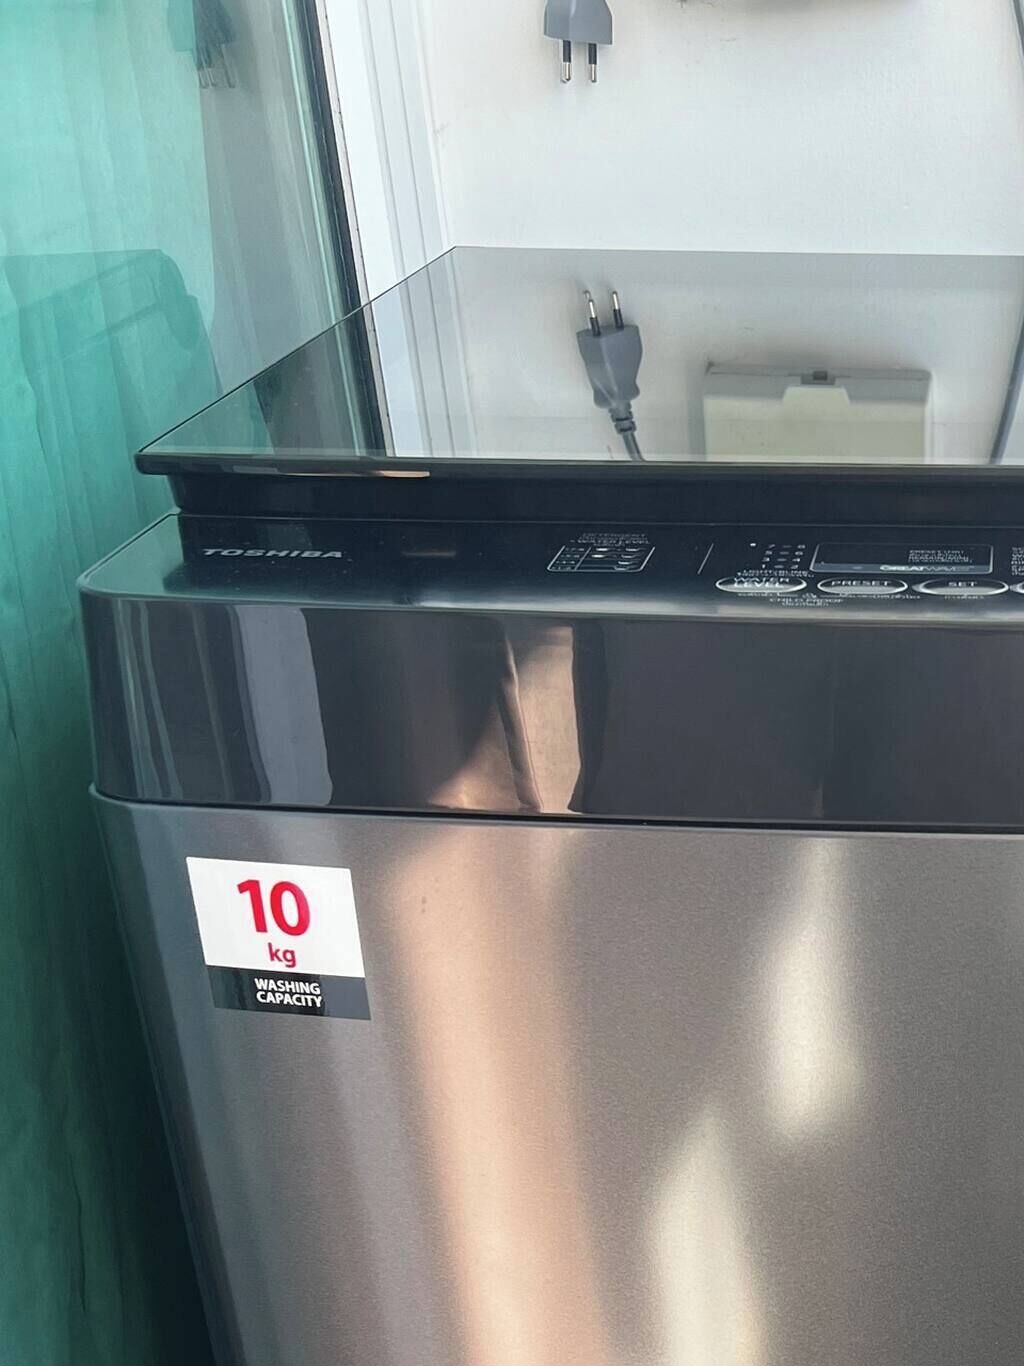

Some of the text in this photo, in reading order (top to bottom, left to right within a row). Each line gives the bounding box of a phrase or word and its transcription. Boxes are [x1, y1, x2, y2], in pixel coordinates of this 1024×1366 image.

[202, 547, 343, 559] TOSHIBA
[831, 579, 892, 587] PRESET
[237, 879, 311, 937] 10
[267, 942, 297, 968] kg
[253, 977, 321, 995] WASHING
[256, 991, 322, 1008] CAPACITY
